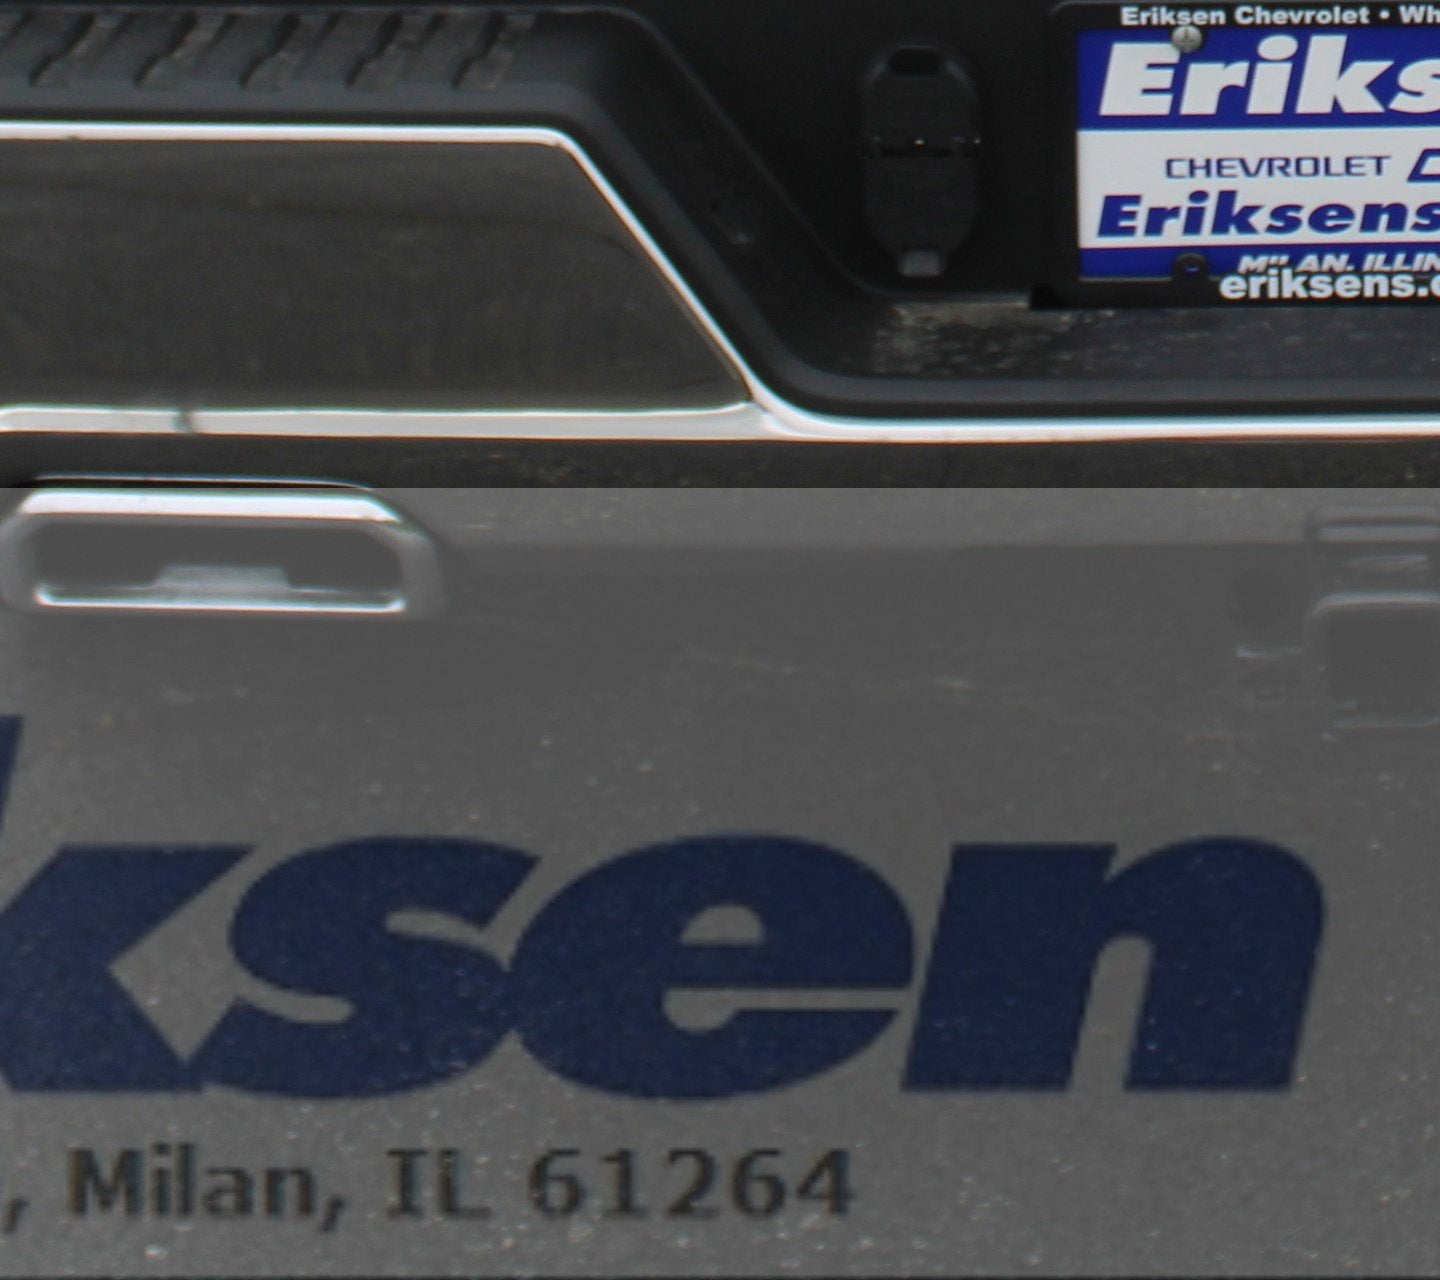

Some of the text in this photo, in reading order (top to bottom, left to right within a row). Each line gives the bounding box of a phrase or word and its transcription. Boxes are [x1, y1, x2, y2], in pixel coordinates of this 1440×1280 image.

[1120, 5, 1226, 26] Eriksen
[1233, 5, 1370, 25] Chevrolet
[1165, 155, 1392, 180] CHEVROLET
